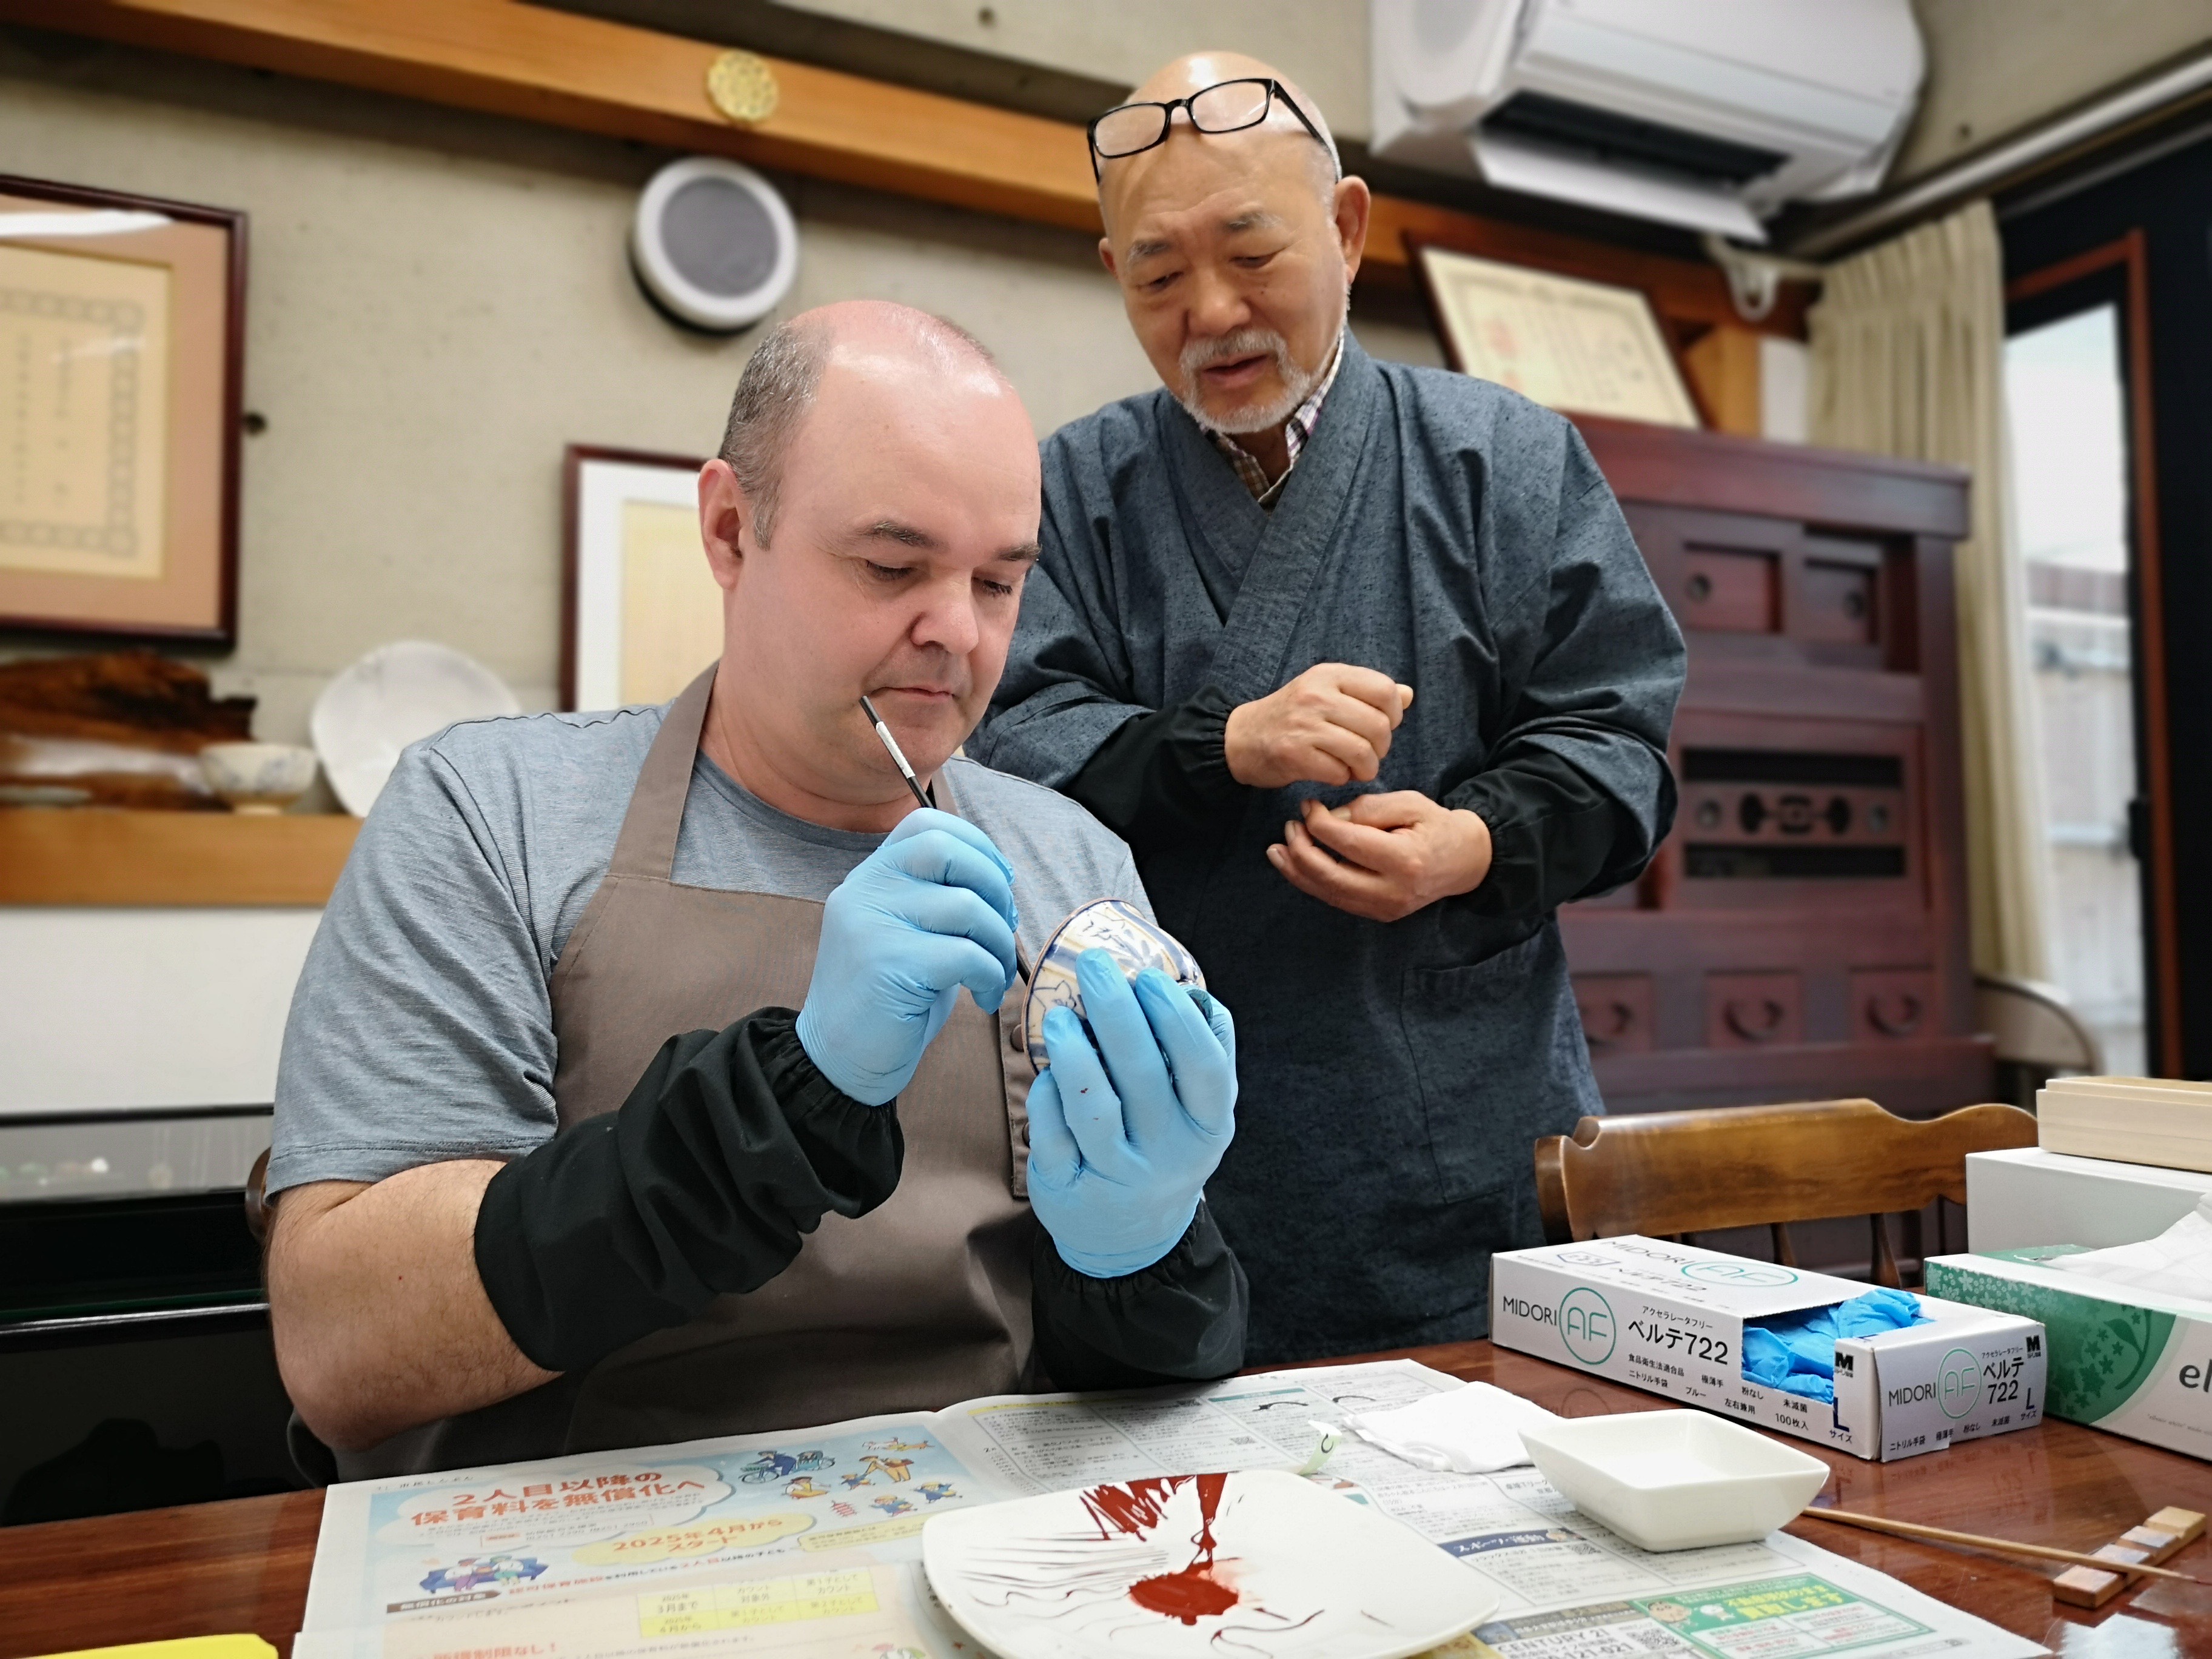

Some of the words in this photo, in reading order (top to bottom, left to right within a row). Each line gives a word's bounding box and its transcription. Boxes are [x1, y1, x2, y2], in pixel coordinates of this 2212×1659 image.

[1601, 1241, 1695, 1265] MIDORI
[1503, 1295, 1557, 1326] MIDORI
[1567, 1307, 1607, 1341] AF
[1643, 1305, 1713, 1329] アクセラレータフリー
[1628, 1320, 1728, 1365] ベルテ722
[2026, 1335, 2040, 1352] M
[1835, 1352, 1854, 1371] M
[1983, 1356, 2024, 1380] ベルテ
[1741, 1386, 1764, 1399] 粉なし
[1888, 1382, 1936, 1407] MIDORI
[1944, 1367, 1975, 1400] AF
[1988, 1379, 2019, 1404] 722
[2026, 1387, 2035, 1410] L
[1629, 1370, 1668, 1388] ニトリル手袋
[1724, 1398, 1755, 1415] 左右兼用
[1775, 1413, 1809, 1431] 100枚入
[1833, 1396, 1850, 1432] L
[2020, 1410, 2036, 1421] サイズ
[1829, 1429, 1852, 1444] サイズ
[1890, 1435, 1925, 1451] ニトリル手袋
[453, 1472, 662, 1506] 2人目以降の
[411, 1480, 705, 1526] 保育料を無償化へ
[612, 1520, 783, 1552] 2025年4月から
[668, 1535, 738, 1553] スタート
